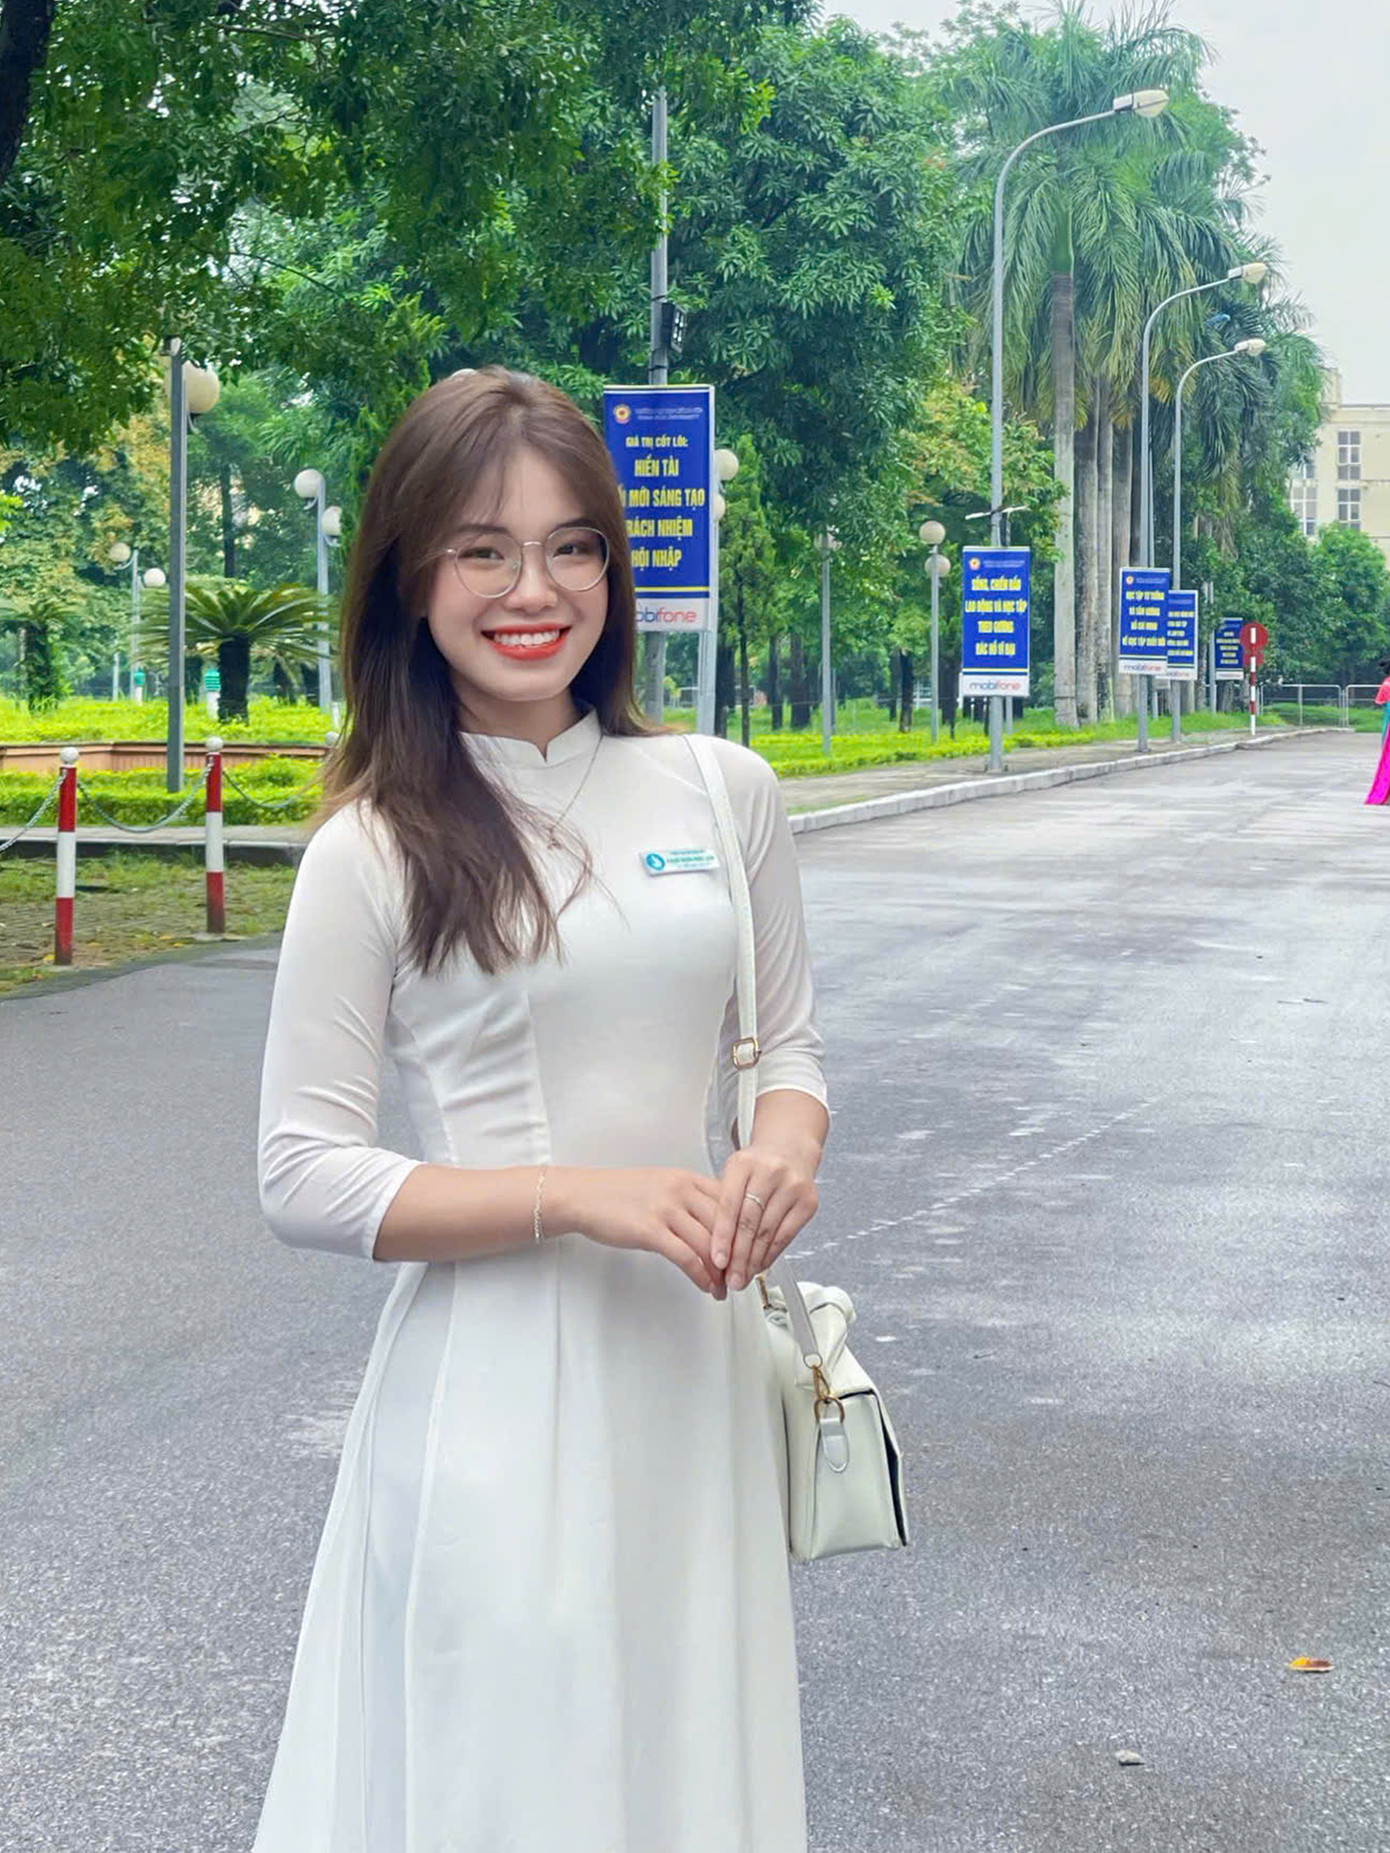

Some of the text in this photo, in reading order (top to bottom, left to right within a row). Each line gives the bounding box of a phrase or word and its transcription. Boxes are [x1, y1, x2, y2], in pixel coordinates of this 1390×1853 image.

[662, 455, 679, 477] TÀI
[629, 485, 650, 507] MỚI
[652, 485, 682, 507] SÁNG
[684, 488, 705, 511] TẠO
[625, 515, 693, 541] RÁCH NHIỆM
[652, 545, 682, 571] NHẬP
[635, 607, 697, 623] obifone
[970, 680, 1021, 691] mobifone
